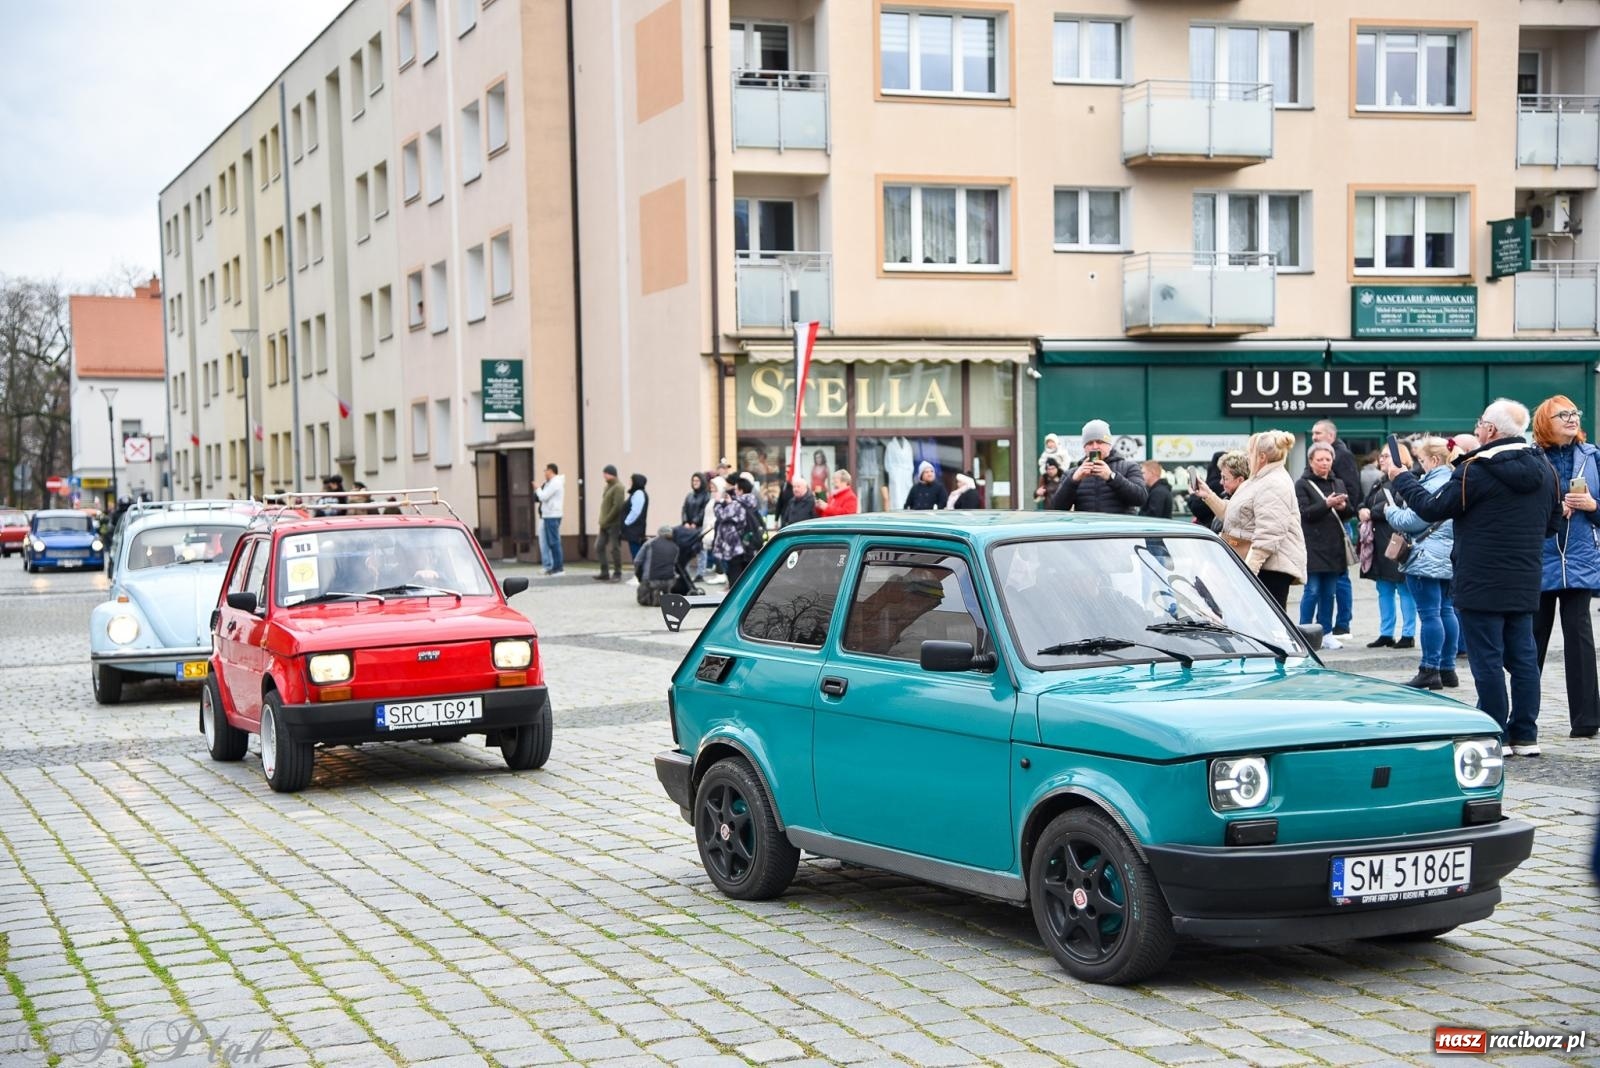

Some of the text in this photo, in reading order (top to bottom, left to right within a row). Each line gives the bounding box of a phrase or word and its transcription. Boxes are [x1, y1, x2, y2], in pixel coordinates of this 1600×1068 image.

[1376, 294, 1474, 304] KANCELARIE ADWOKACKIE
[747, 367, 951, 417] STELLA
[1230, 371, 1417, 396] JUBILER
[1274, 400, 1306, 411] 1989
[389, 700, 474, 724] SRC TG91
[1351, 850, 1466, 892] SM 5186E
[1333, 881, 1344, 891] PL
